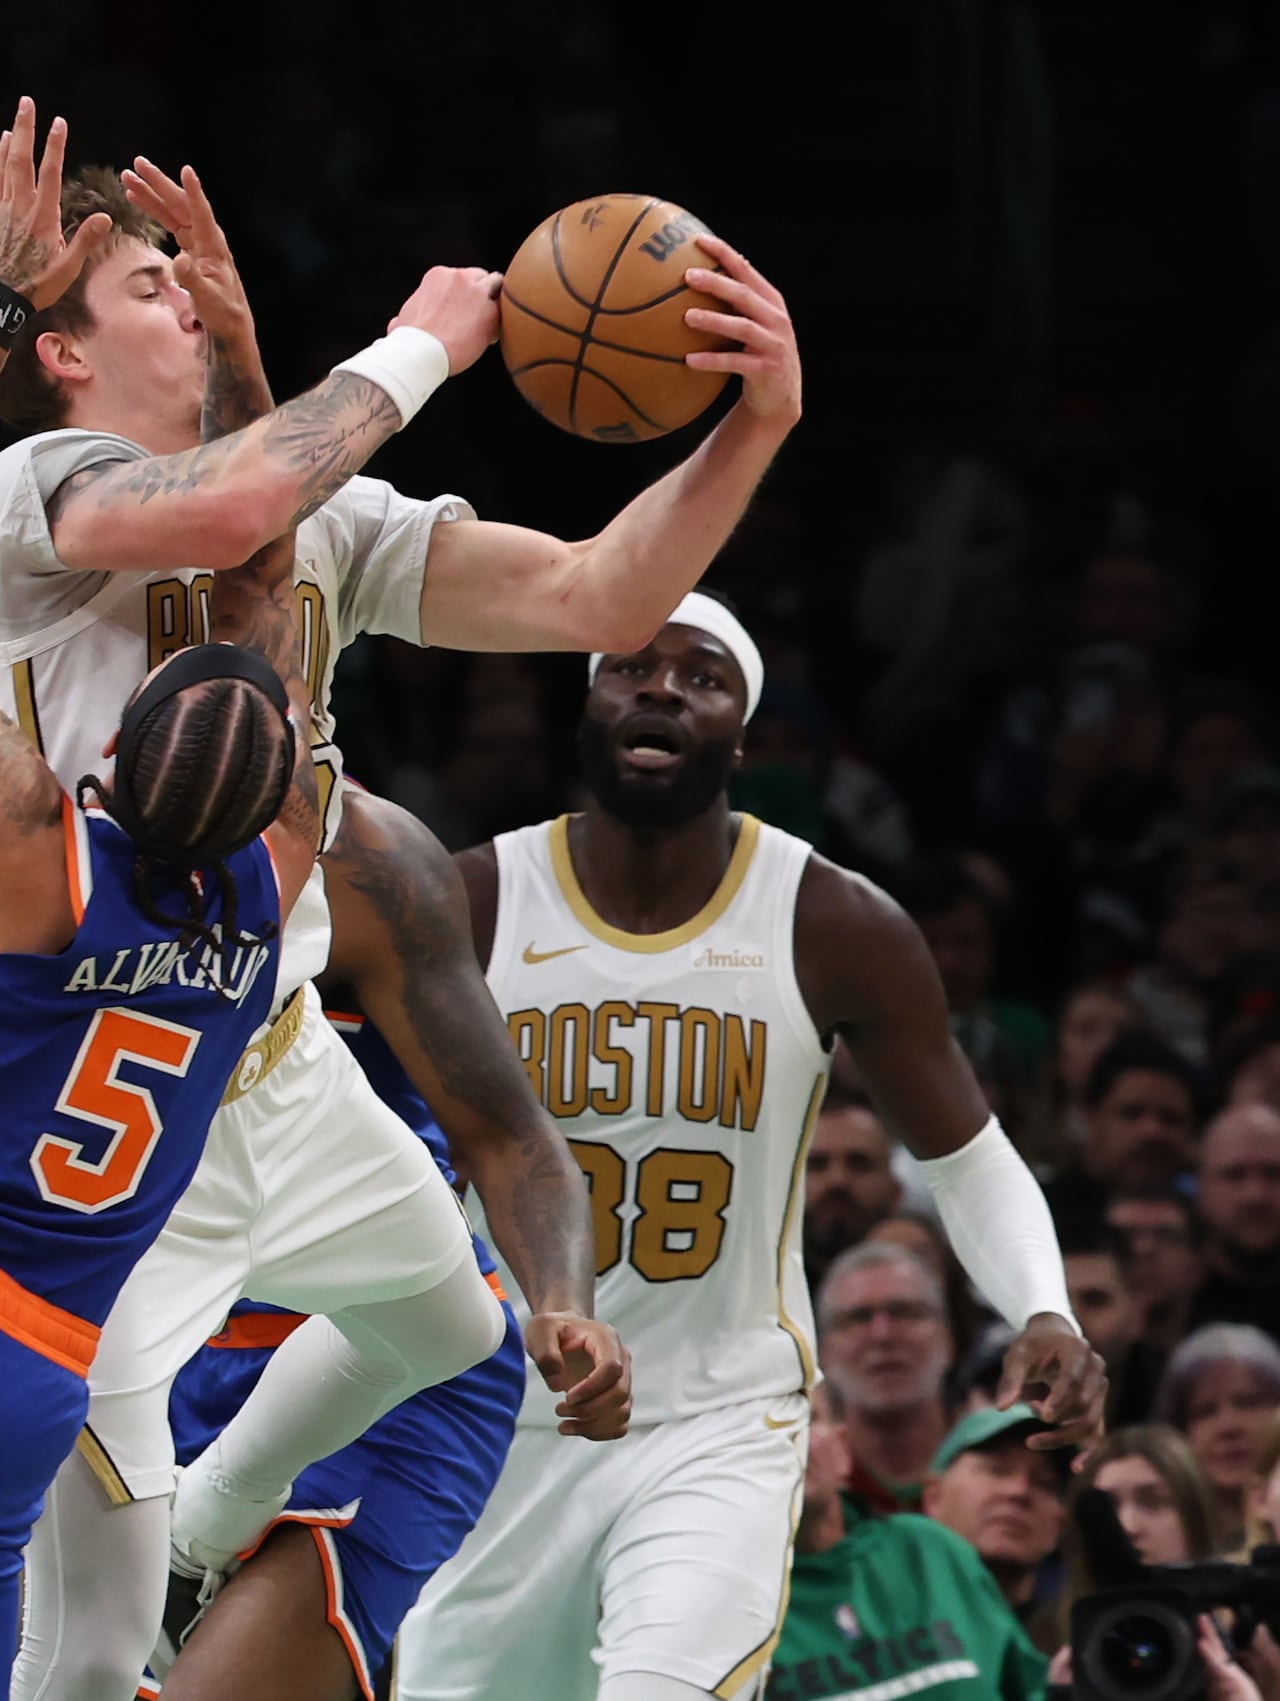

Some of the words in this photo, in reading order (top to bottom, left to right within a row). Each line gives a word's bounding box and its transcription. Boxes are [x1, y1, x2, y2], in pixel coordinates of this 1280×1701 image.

[693, 947, 764, 968] Amica
[29, 1006, 203, 1215] 5
[508, 1000, 767, 1132] BOSTON
[764, 1620, 965, 1701] CELTICS
